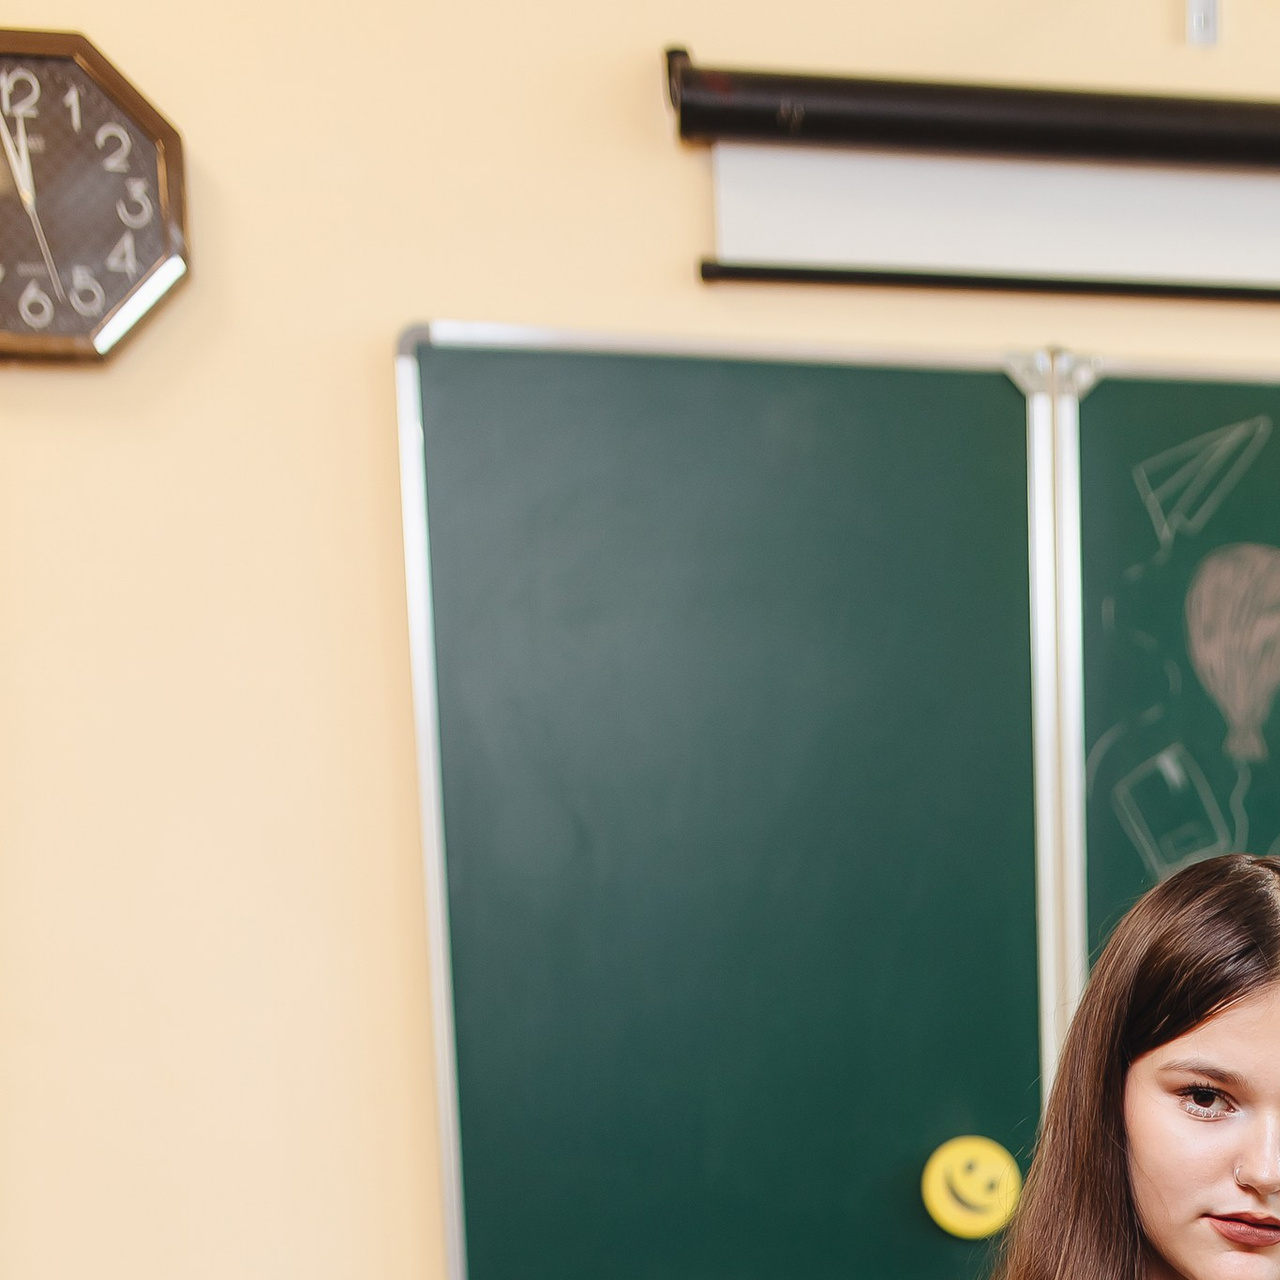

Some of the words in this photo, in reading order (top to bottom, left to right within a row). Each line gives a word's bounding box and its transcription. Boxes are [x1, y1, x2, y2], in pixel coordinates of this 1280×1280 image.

[62, 84, 83, 133] 1
[95, 121, 132, 173] 2
[116, 177, 153, 230] 3
[105, 230, 138, 282] 4
[17, 277, 55, 331] 6
